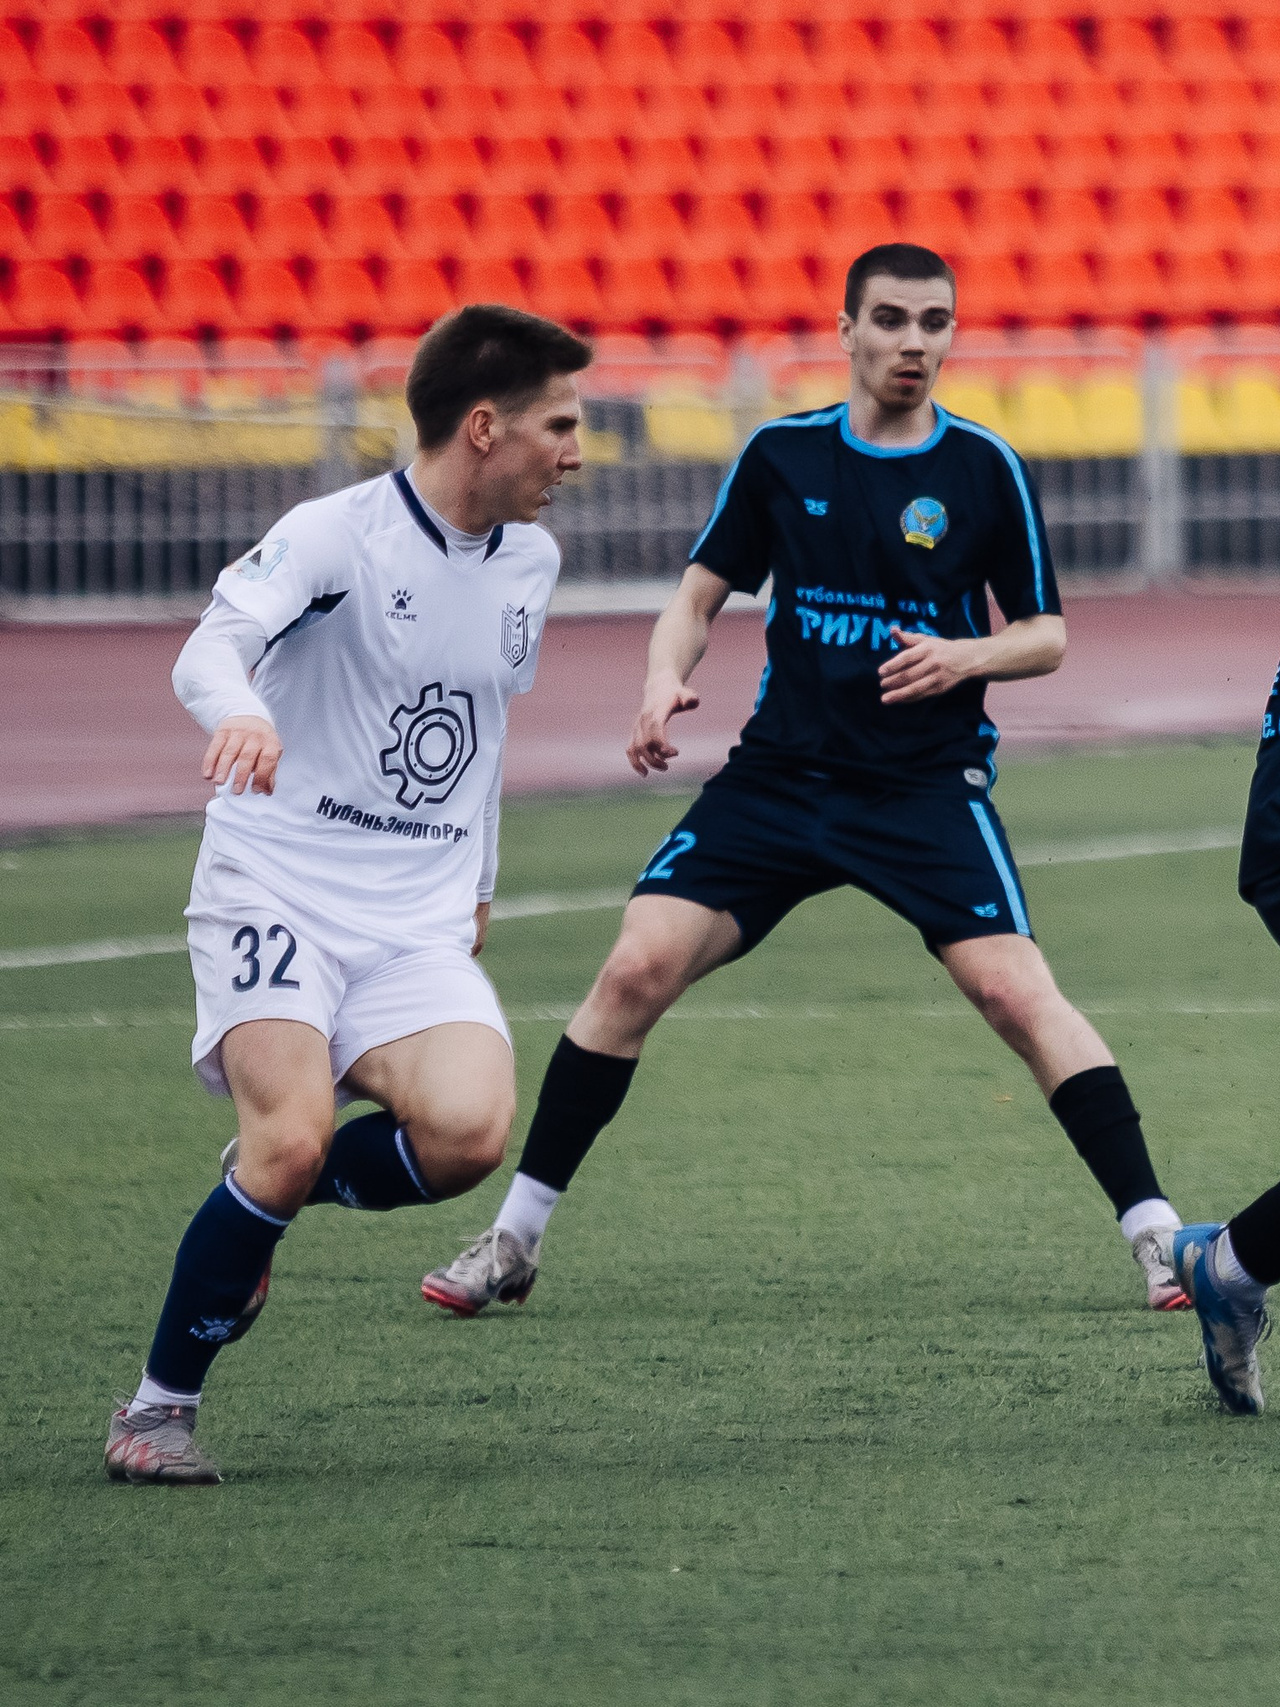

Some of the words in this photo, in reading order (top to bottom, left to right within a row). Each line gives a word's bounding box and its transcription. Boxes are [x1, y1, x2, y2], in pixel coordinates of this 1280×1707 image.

[385, 611, 417, 622] KELME
[637, 831, 697, 883] 2
[231, 923, 301, 993] 32
